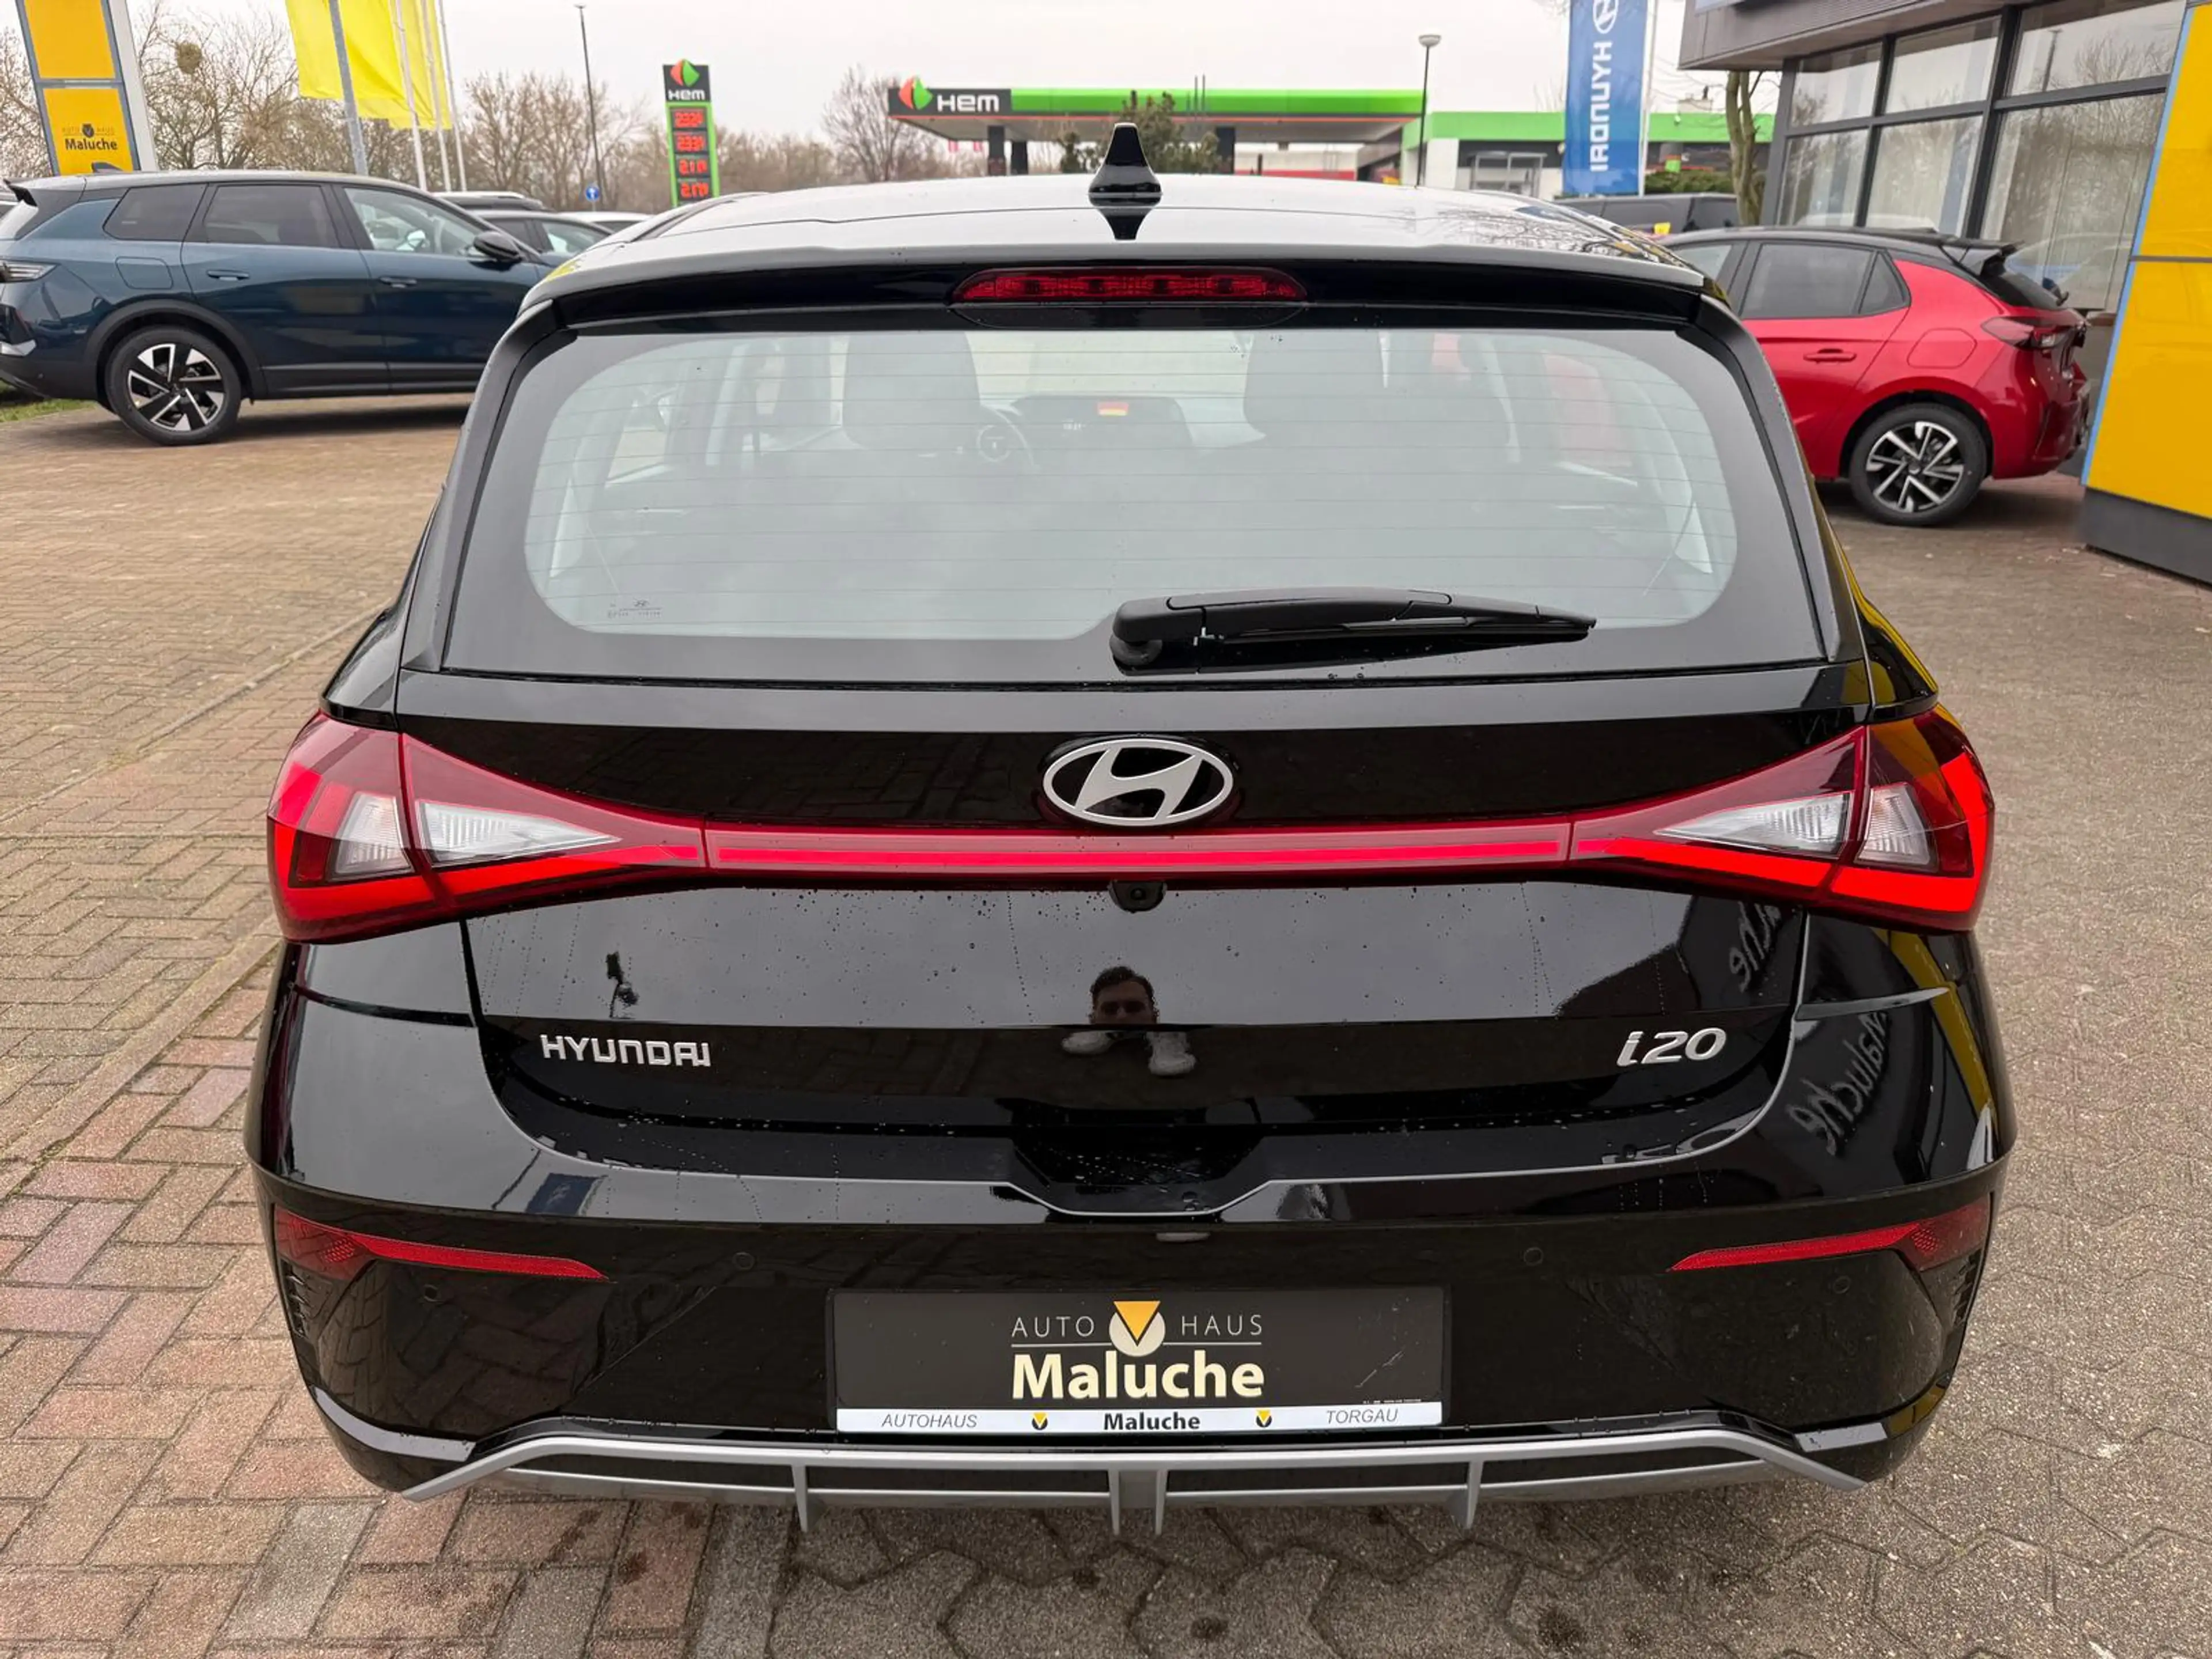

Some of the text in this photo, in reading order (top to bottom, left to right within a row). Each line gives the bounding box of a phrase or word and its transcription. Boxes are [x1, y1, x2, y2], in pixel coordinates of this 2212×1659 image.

[1590, 41, 1612, 172] HYUNDAI
[65, 138, 118, 151] Maluche
[540, 1034, 711, 1067] HYUNDAI
[1616, 1027, 1727, 1067] i20
[1011, 1314, 1263, 1338] AUTO HAUS
[1012, 1349, 1266, 1399] Maluche
[881, 1408, 1399, 1431] AUTOHAUS Maluche TORGAU
